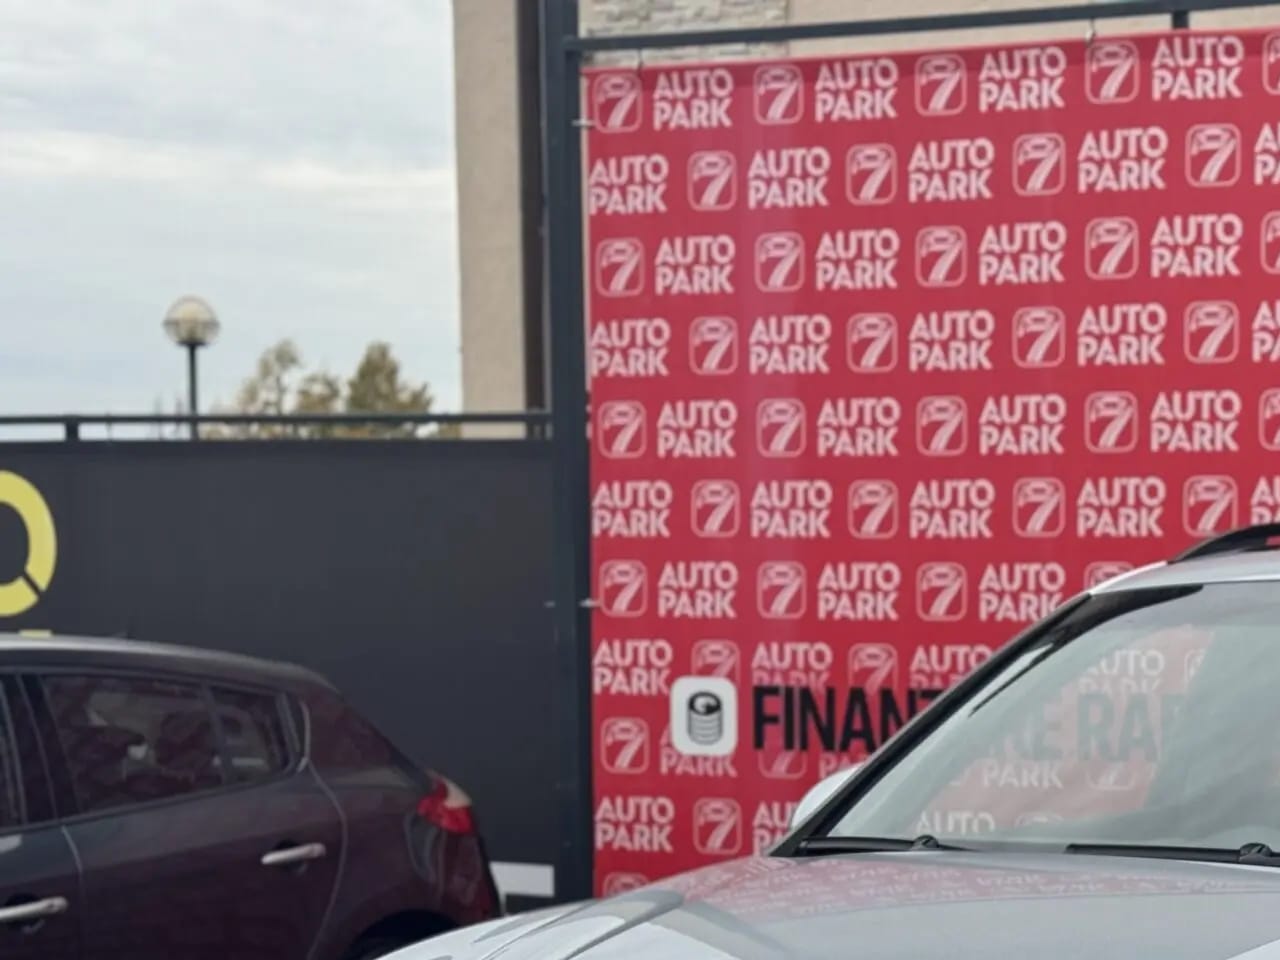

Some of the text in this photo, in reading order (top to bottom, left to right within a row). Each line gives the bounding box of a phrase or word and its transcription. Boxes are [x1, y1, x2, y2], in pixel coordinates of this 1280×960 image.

[979, 47, 1066, 80] AUTO
[1152, 36, 1243, 68] AUTO
[654, 69, 733, 99] AUTO
[815, 60, 897, 90] AUTO
[1152, 66, 1242, 100] PARK
[815, 87, 896, 122] PARK
[979, 77, 1064, 112] PARK
[654, 98, 732, 130] PARK
[908, 138, 994, 172] AUTO
[1078, 126, 1168, 161] AUTO
[588, 155, 668, 186] AUTO
[748, 147, 830, 178] AUTO
[1079, 157, 1165, 192] PARK
[589, 183, 666, 215] PARK
[748, 176, 827, 209] PARK
[909, 168, 992, 202] PARK
[816, 228, 899, 260] AUTO
[979, 221, 1066, 255] AUTO
[1151, 214, 1242, 246] AUTO
[655, 235, 735, 266] AUTO
[1151, 244, 1240, 277] PARK
[656, 263, 733, 294] PARK
[816, 258, 897, 290] PARK
[980, 251, 1064, 285] PARK
[591, 319, 670, 348] AUTO
[749, 315, 831, 345] AUTO
[909, 310, 994, 342] AUTO
[1078, 303, 1166, 335] AUTO
[591, 346, 668, 377] PARK
[750, 343, 828, 374] PARK
[910, 340, 991, 371] PARK
[1078, 333, 1164, 365] PARK
[657, 400, 737, 430] AUTO
[817, 397, 900, 427] AUTO
[979, 394, 1066, 425] AUTO
[1151, 390, 1241, 422] AUTO
[658, 428, 735, 457] PARK
[818, 426, 897, 456] PARK
[980, 423, 1063, 455] PARK
[1151, 420, 1238, 452] PARK
[592, 480, 672, 510] AUTO
[751, 480, 832, 510] AUTO
[910, 479, 995, 510] AUTO
[1077, 476, 1165, 506] AUTO
[592, 508, 669, 537] PARK
[751, 508, 829, 537] PARK
[910, 508, 992, 538] PARK
[1077, 506, 1162, 536] PARK
[658, 561, 738, 590] AUTO
[818, 562, 900, 591] AUTO
[979, 562, 1065, 592] AUTO
[658, 588, 735, 618] PARK
[818, 591, 898, 620] PARK
[979, 591, 1062, 621] PARK
[594, 640, 673, 667] AUTO
[752, 642, 833, 670] AUTO
[593, 667, 670, 695] PARK
[660, 752, 737, 778] PARK
[595, 796, 674, 824] AUTO
[595, 821, 672, 851] PARK
